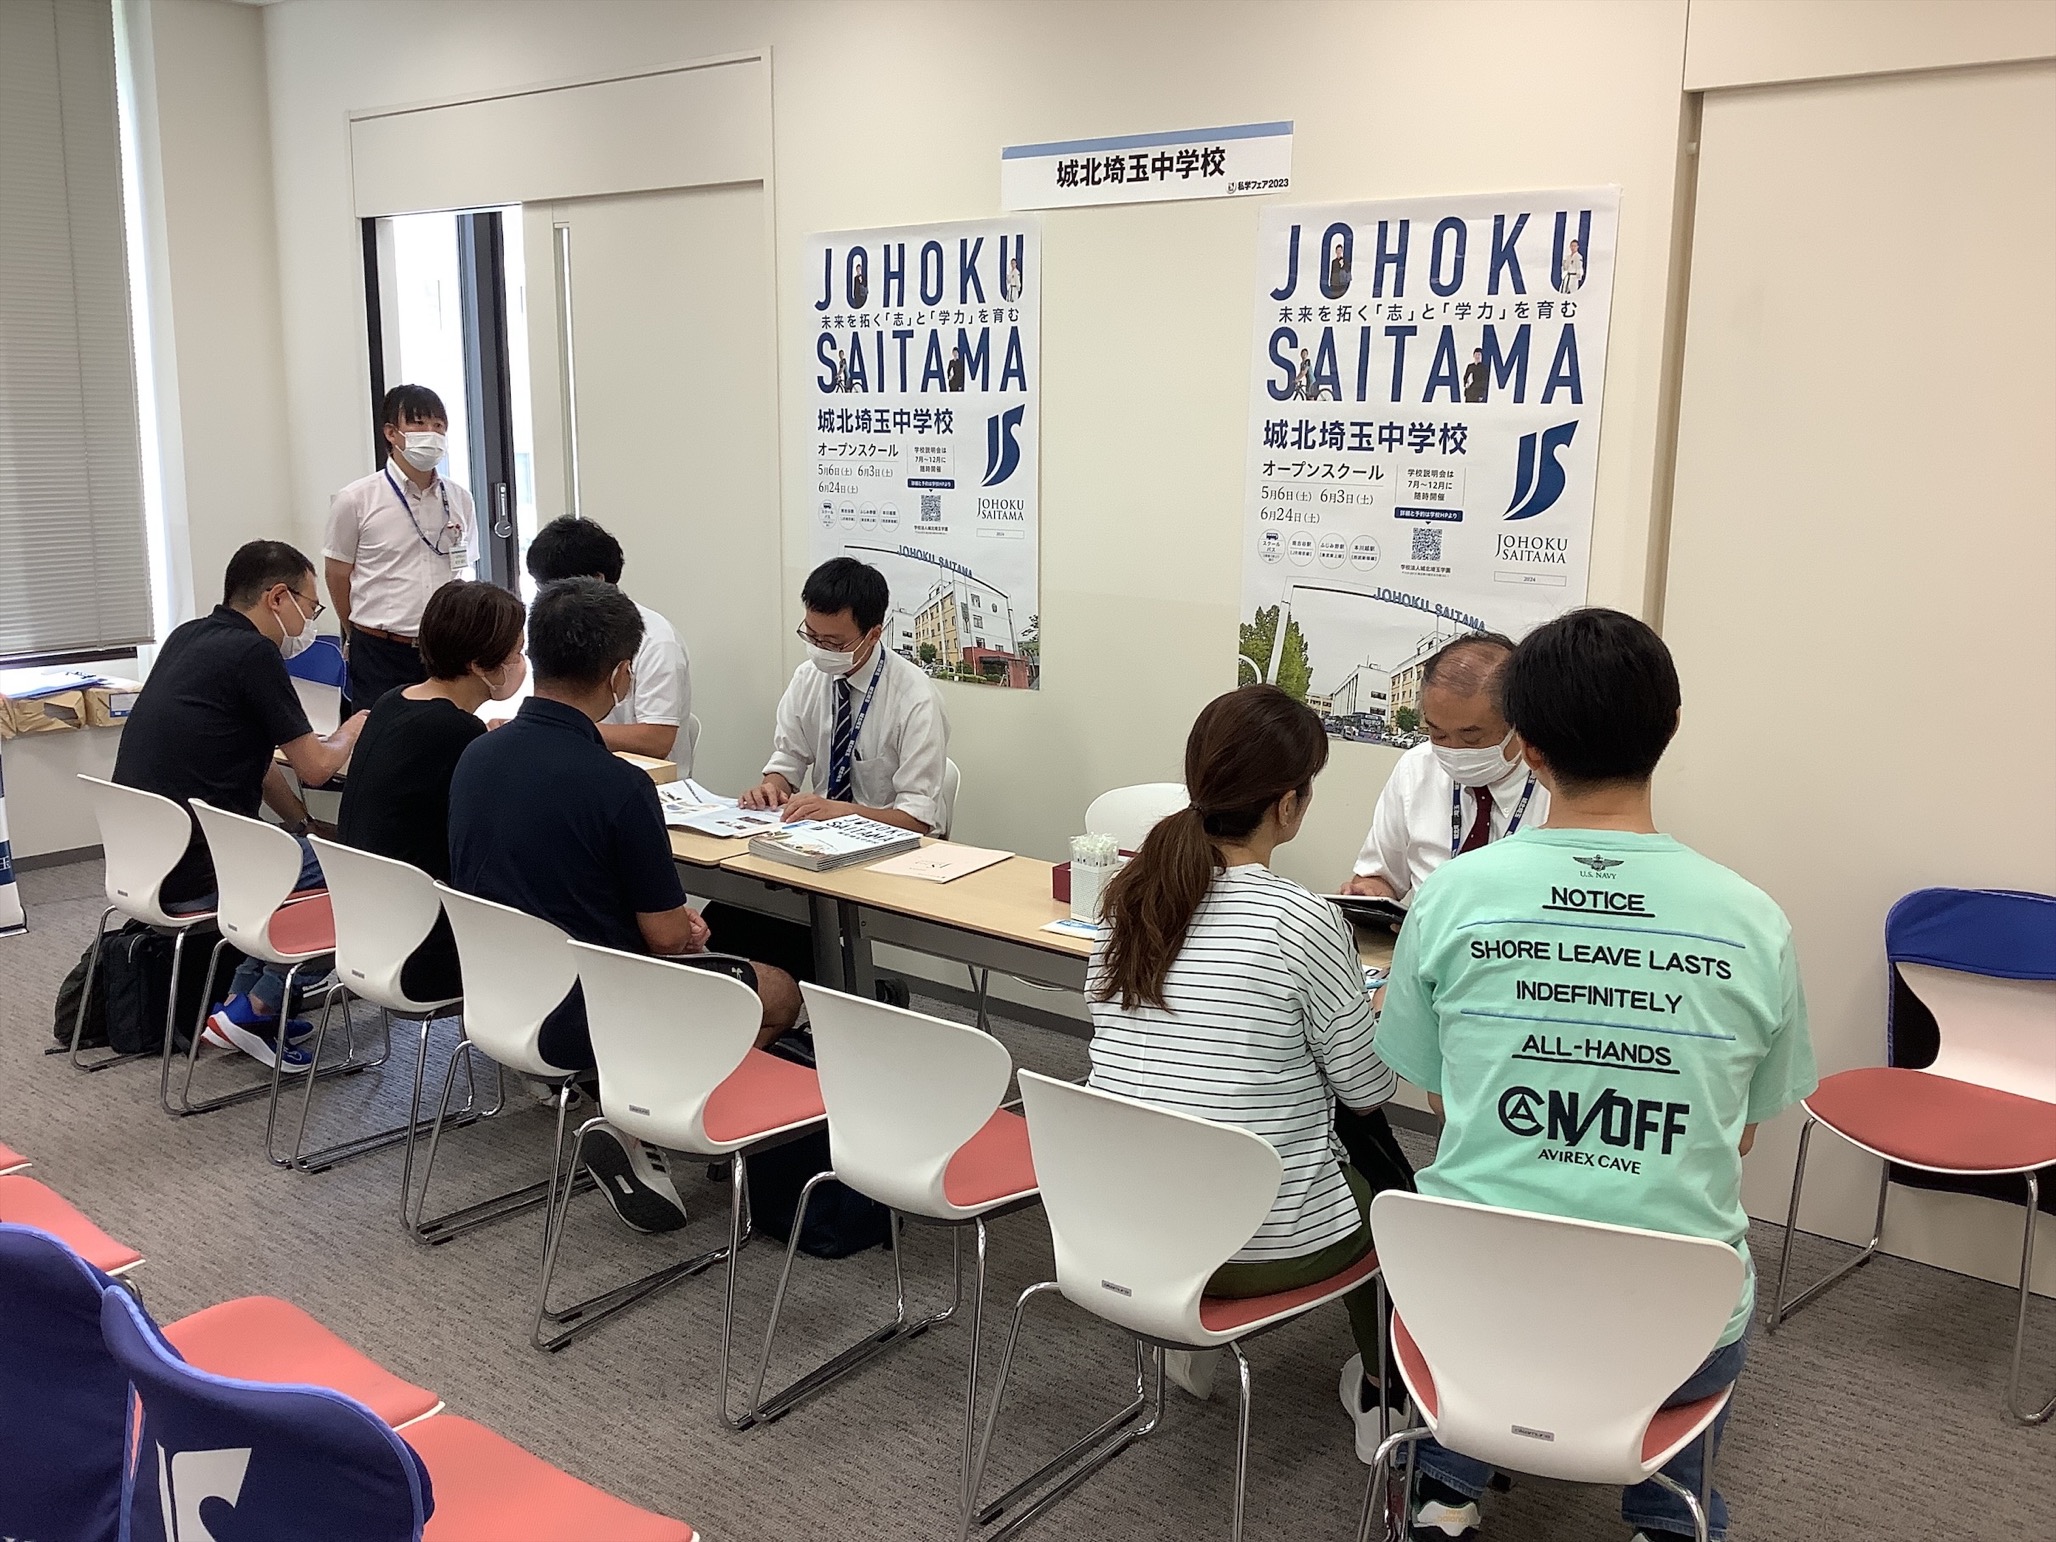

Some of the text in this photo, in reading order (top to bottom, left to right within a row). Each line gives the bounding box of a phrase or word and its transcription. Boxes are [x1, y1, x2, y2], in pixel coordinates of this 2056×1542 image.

[1056, 146, 1226, 188] 城北埼玉中学校
[1238, 178, 1289, 191] 私学フェア2023
[1270, 210, 1592, 301] JOHOKU
[814, 234, 1024, 311] JOHOKU
[821, 307, 1020, 329] 未来を拓く「志」と「学力」を育む
[1278, 300, 1579, 323] 未来を拓く「志」と「学力」を育む
[816, 325, 1028, 394] SAITAMA
[1266, 323, 1584, 404] SAITAMA
[817, 407, 954, 435] 城北埼玉中学校
[817, 442, 899, 458] オープンスクール
[1263, 419, 1468, 456] 城北埼玉中学校
[1262, 460, 1385, 482] オープンスクール
[1407, 468, 1455, 478] 学校説明会は
[976, 497, 1024, 517] JOHOKU
[981, 509, 1024, 521] SAITAMA
[1494, 533, 1568, 558] JOHOKU
[1502, 548, 1566, 564] SAITAMA
[1373, 587, 1486, 632] JOHOKU SAITAMA
[1580, 870, 1617, 880] U.S. NAVY
[1551, 886, 1645, 912] NOTICE
[1470, 940, 1732, 980] SHORE LEAVE LASTS
[1516, 980, 1683, 1014] INDEFINITELY
[1521, 1034, 1672, 1066] ALL-HANDS
[1538, 1149, 1642, 1175] AVIREX CAVE
